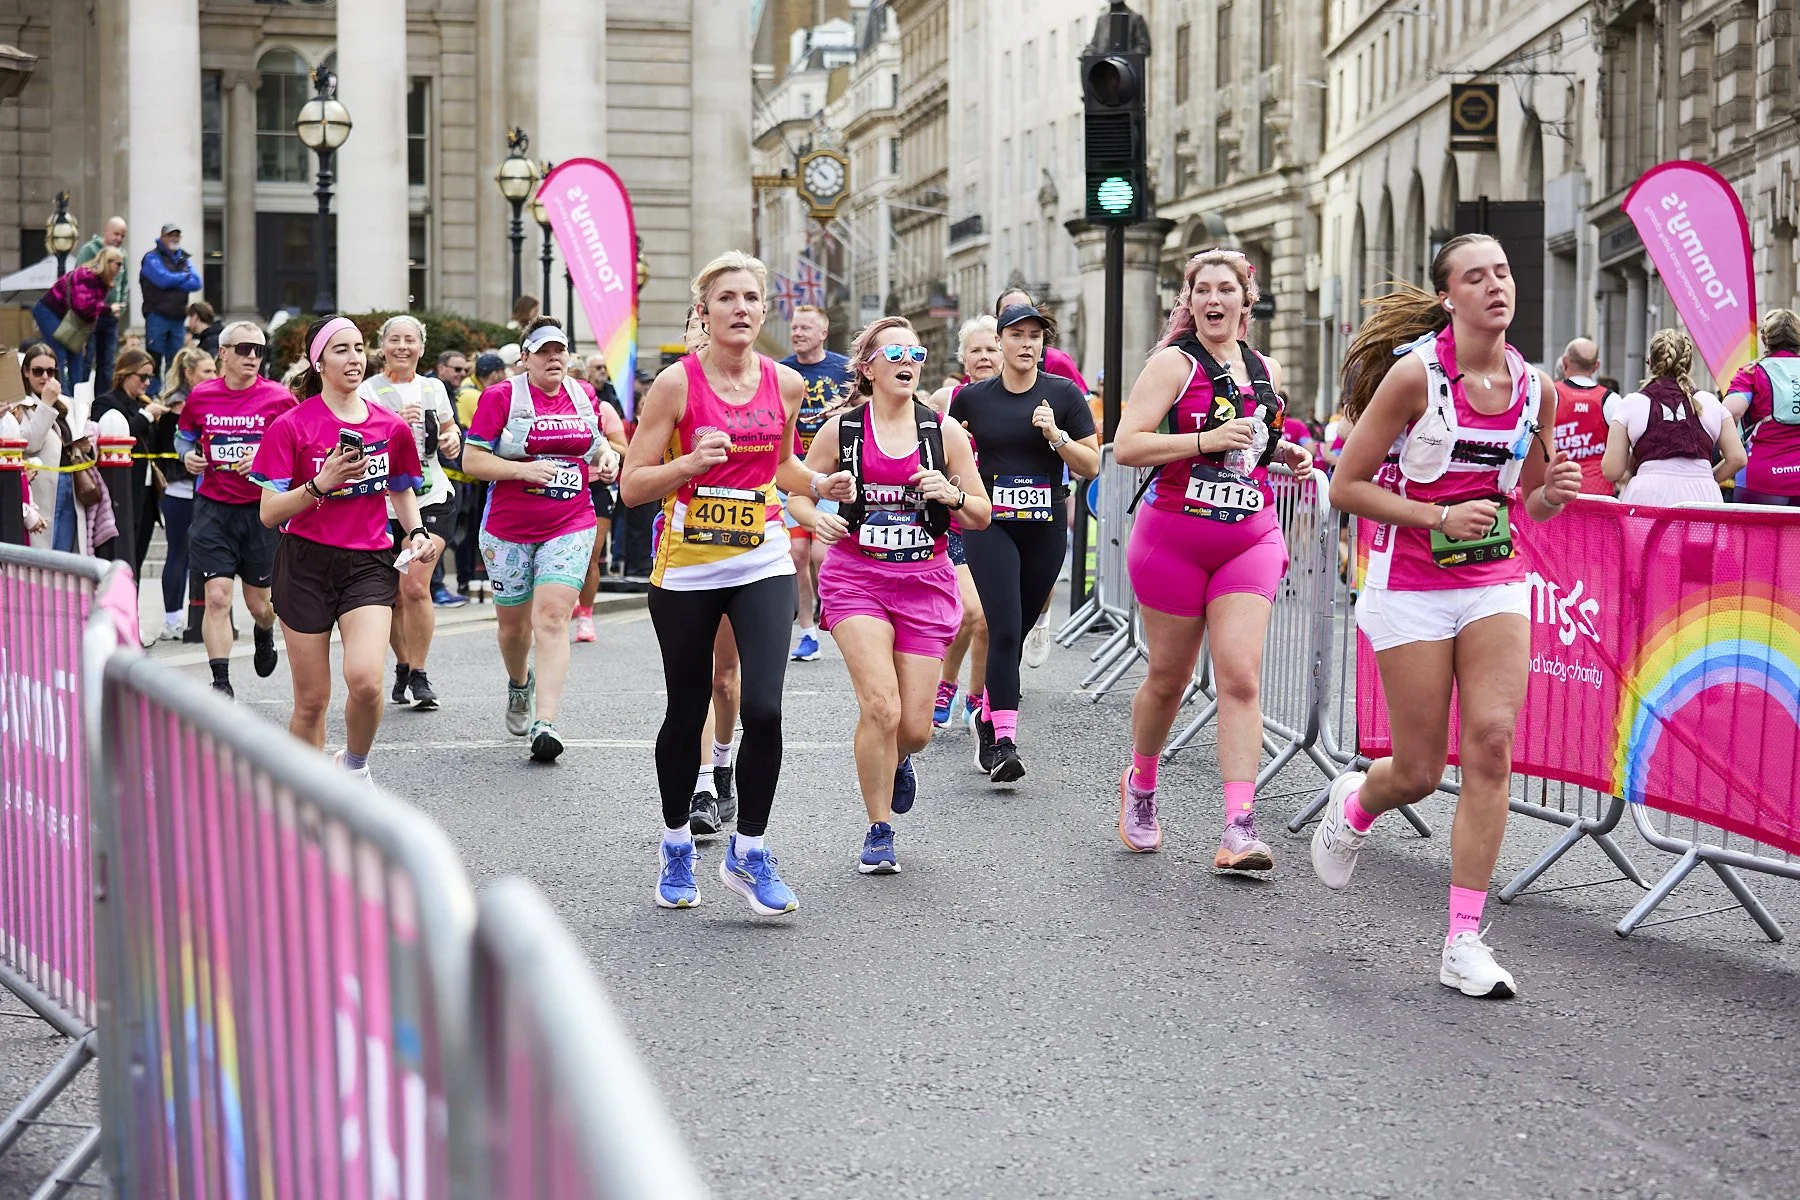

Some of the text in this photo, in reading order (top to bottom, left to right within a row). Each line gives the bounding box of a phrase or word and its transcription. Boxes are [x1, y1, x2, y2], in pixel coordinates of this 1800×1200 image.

[1573, 403, 1589, 413] JON
[205, 413, 265, 428] Tommy's
[725, 409, 777, 429] LUCY
[730, 432, 782, 442] Brain Tumo
[363, 443, 376, 453] ARIA
[731, 442, 774, 453] Research
[1567, 442, 1606, 460] VING
[553, 471, 579, 487] 132
[709, 487, 732, 496] LUCY
[998, 489, 1046, 505] 11931
[1195, 482, 1259, 508] 11113
[695, 503, 754, 527] 4015
[887, 514, 911, 522] KAREN
[866, 526, 929, 546] 11114
[1374, 525, 1387, 547] BREA
